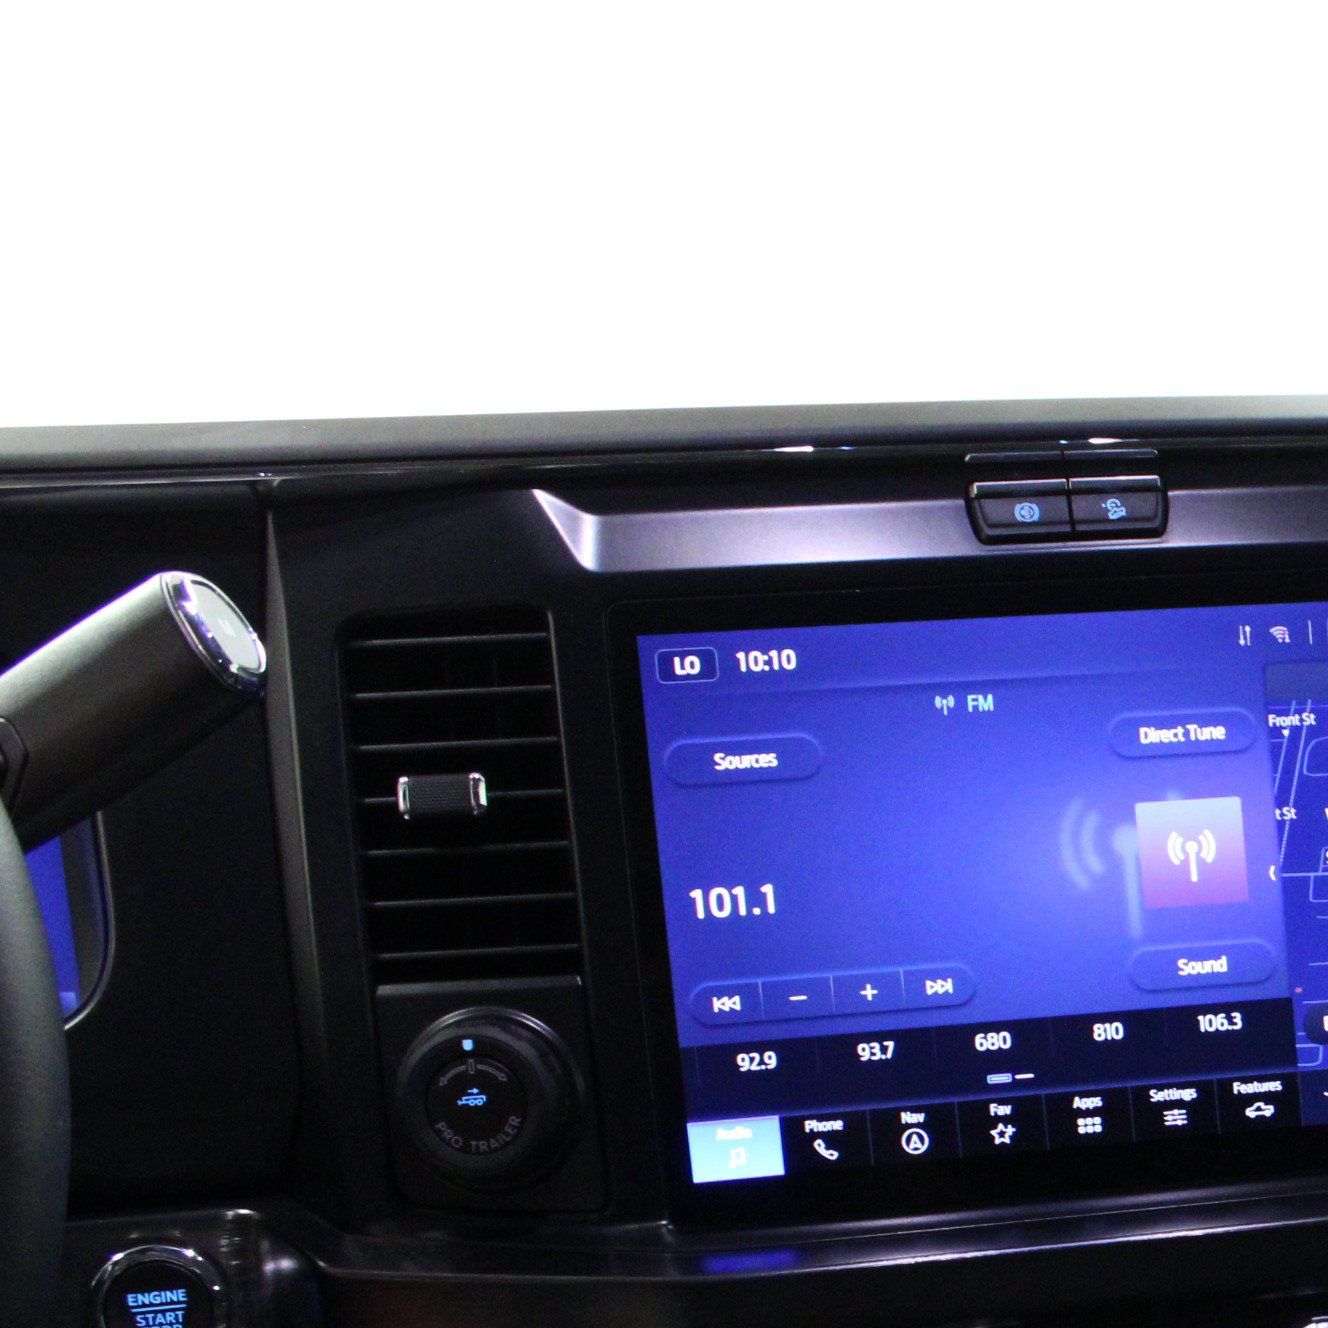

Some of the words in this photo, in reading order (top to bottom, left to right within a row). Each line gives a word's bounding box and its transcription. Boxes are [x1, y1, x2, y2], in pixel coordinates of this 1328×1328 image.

[673, 655, 701, 676] LO
[735, 649, 797, 673] 10:10
[967, 694, 995, 713] FM
[1268, 714, 1300, 727] Front
[1302, 712, 1316, 726] St
[1139, 725, 1185, 744] Direct
[1186, 723, 1226, 742] Tune
[713, 751, 778, 771] Sources
[1282, 806, 1297, 820] St
[688, 883, 777, 920] 101.1
[1177, 955, 1228, 976] Sound
[1092, 1022, 1124, 1042] 810
[1197, 1012, 1243, 1033] 106.3
[974, 1031, 1012, 1051] 680
[737, 1051, 778, 1072] 92.9
[857, 1041, 895, 1062] 93.7
[1149, 1086, 1198, 1104] Settings
[1233, 1079, 1282, 1095] Features
[989, 1102, 1012, 1116] Fav
[1072, 1094, 1103, 1111] Apps
[804, 1117, 844, 1133] Phone
[900, 1111, 925, 1125] Nav
[435, 1121, 465, 1149] PRO
[469, 1114, 523, 1152] TRAILER
[127, 1288, 188, 1307] ENGINE
[135, 1310, 186, 1327] START
